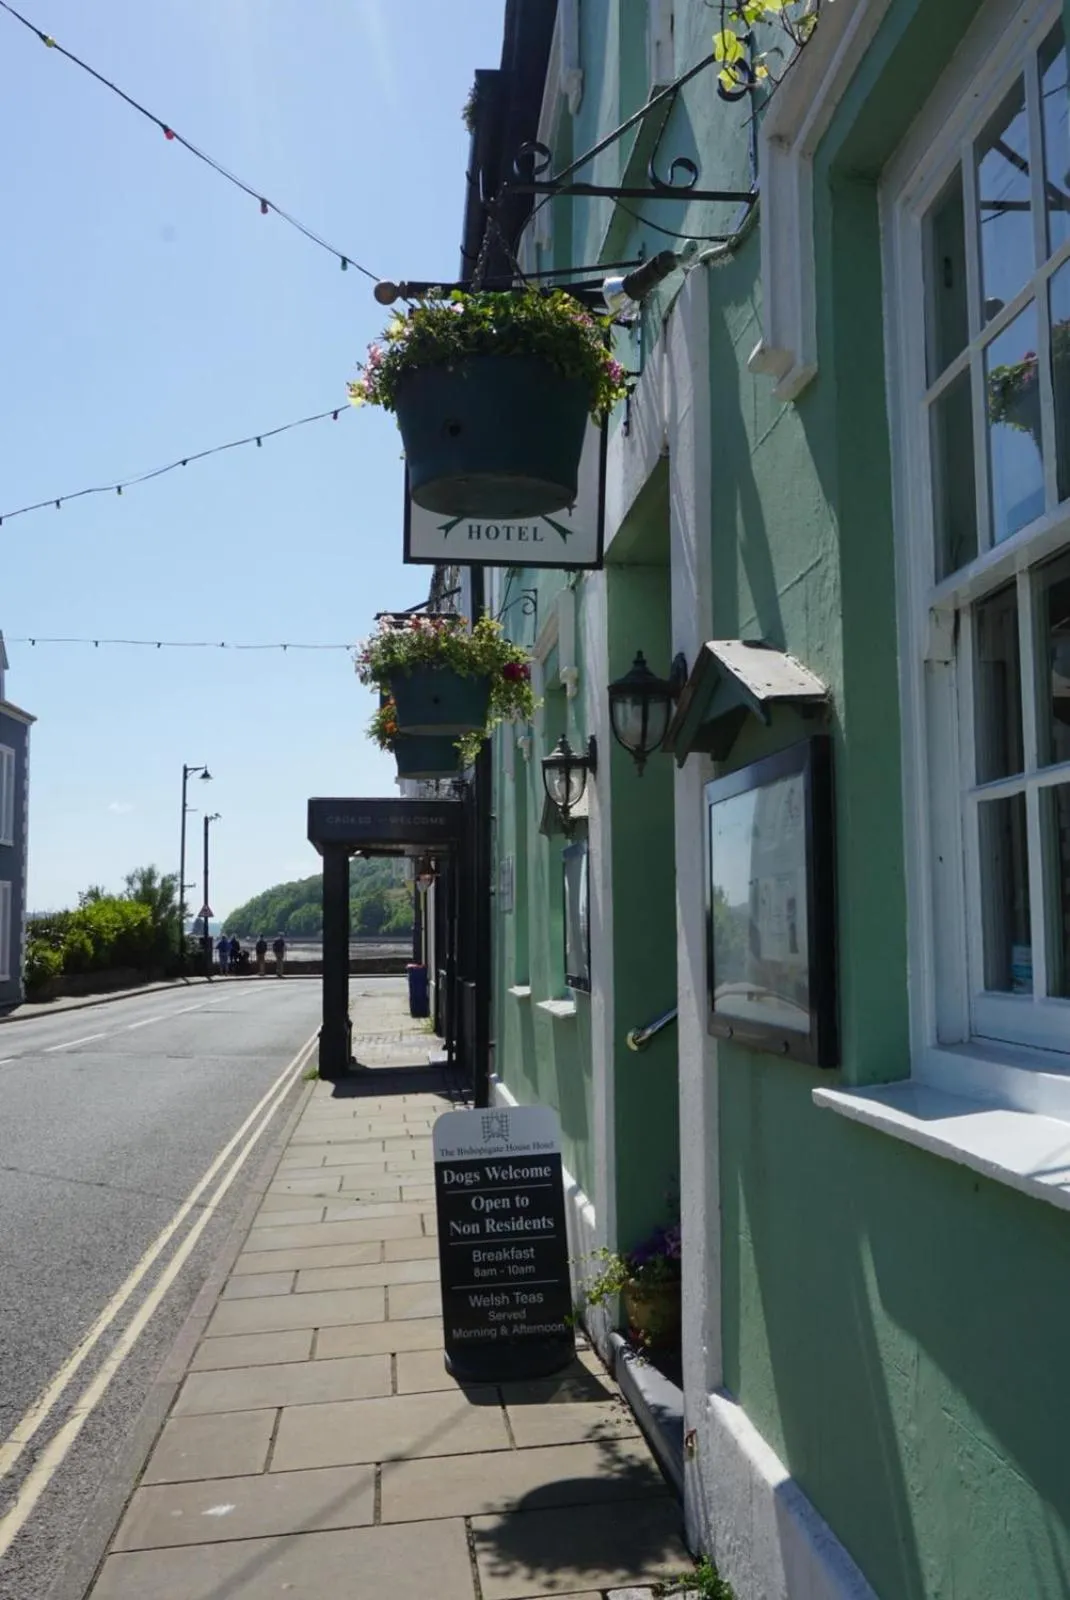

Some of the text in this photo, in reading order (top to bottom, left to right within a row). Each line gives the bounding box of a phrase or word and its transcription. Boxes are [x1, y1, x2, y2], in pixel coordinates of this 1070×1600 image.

[467, 524, 544, 542] HOTEL
[440, 1148, 455, 1157] The
[506, 1142, 530, 1151] House
[532, 1140, 555, 1150] Hotel
[443, 1165, 552, 1186] Dogs Welcome
[471, 1194, 530, 1212] Open to
[449, 1215, 554, 1236] Non Residents
[472, 1247, 535, 1263] Breakfast
[474, 1267, 497, 1277] 8am
[507, 1264, 535, 1275] 10am
[468, 1291, 544, 1308] Welsh Teas
[488, 1308, 527, 1321] Served
[452, 1322, 566, 1340] Morning & Afternoon
